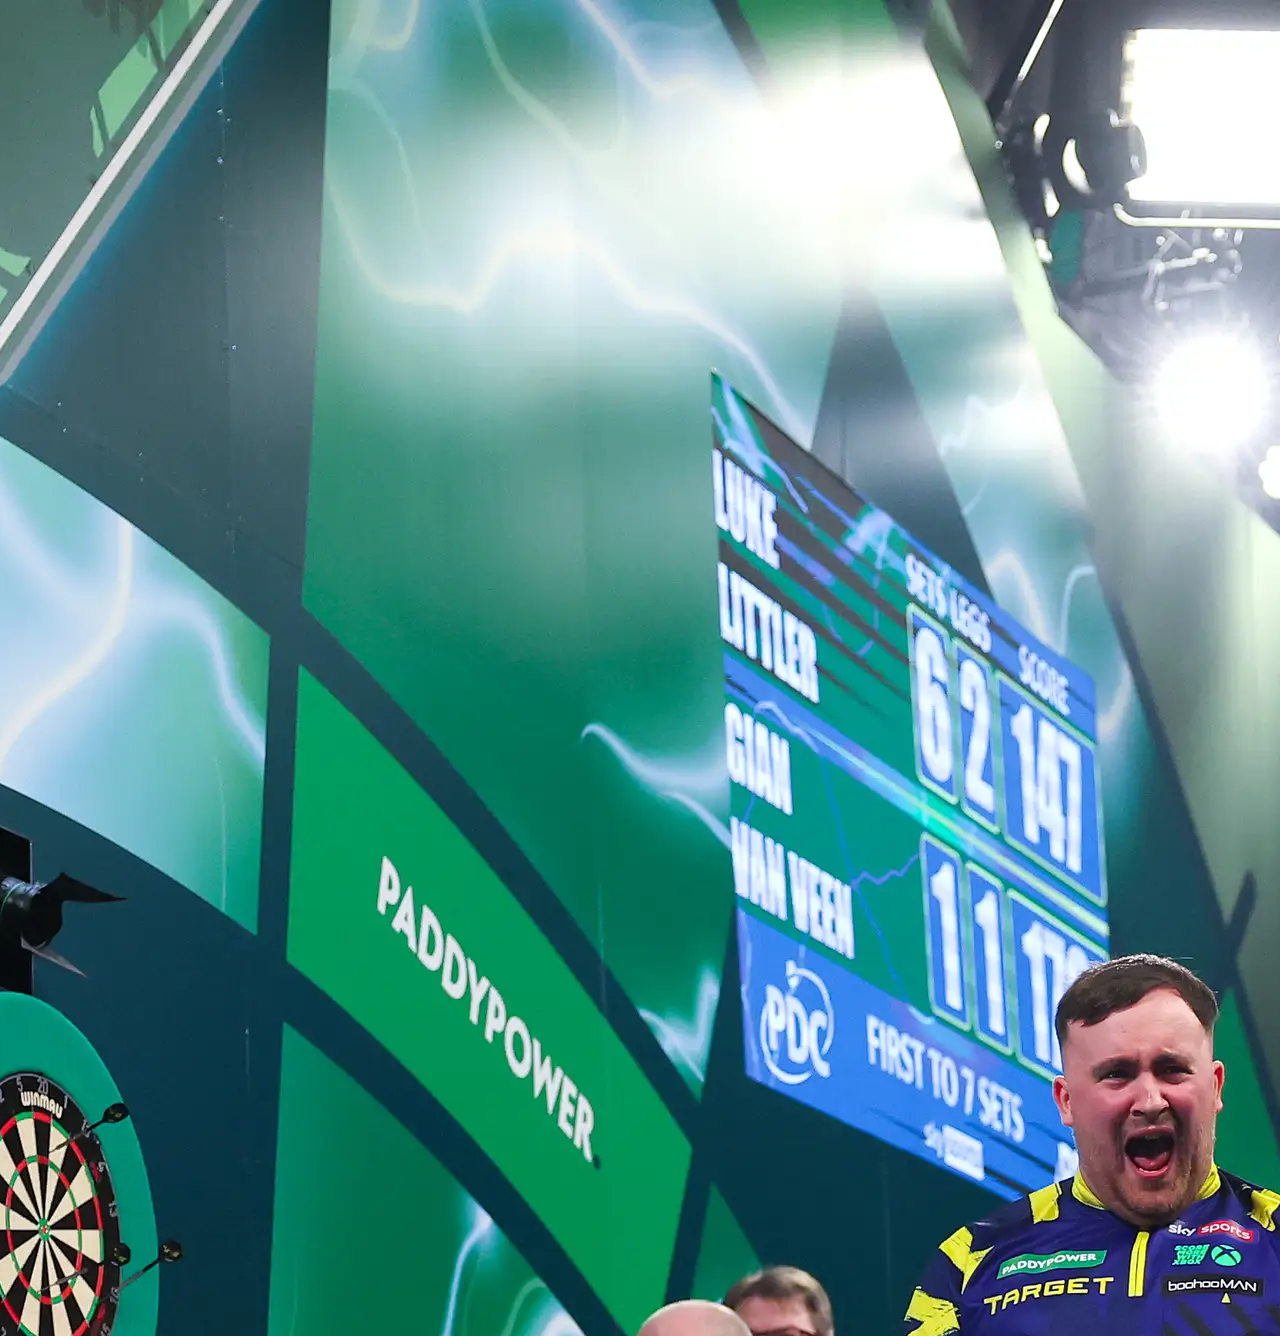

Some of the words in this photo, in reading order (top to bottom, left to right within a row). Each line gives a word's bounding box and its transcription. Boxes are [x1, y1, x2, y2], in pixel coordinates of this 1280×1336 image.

[713, 448, 780, 571] LUKE
[718, 561, 820, 705] LITTLER
[906, 553, 947, 619] SETS
[951, 585, 992, 653] LEGS
[1019, 643, 1071, 717] SCORE
[725, 702, 794, 817] GIAN
[915, 627, 952, 784] 6
[960, 659, 996, 813] 2
[1011, 703, 1083, 875] 147
[731, 815, 787, 922] VAN
[787, 850, 856, 961] VEEN
[931, 861, 963, 1012] 1
[975, 889, 1006, 1037] 1
[765, 983, 831, 1079] PDC
[867, 1013, 925, 1090] FIRST
[928, 1048, 960, 1108] TO
[961, 1068, 975, 1116] 7
[978, 1075, 1025, 1143] SETS
[1168, 1224, 1196, 1237] sky
[1200, 1223, 1251, 1240] sports
[1168, 1279, 1257, 1292] boohooMAN
[983, 1276, 1116, 1316] TARGET
